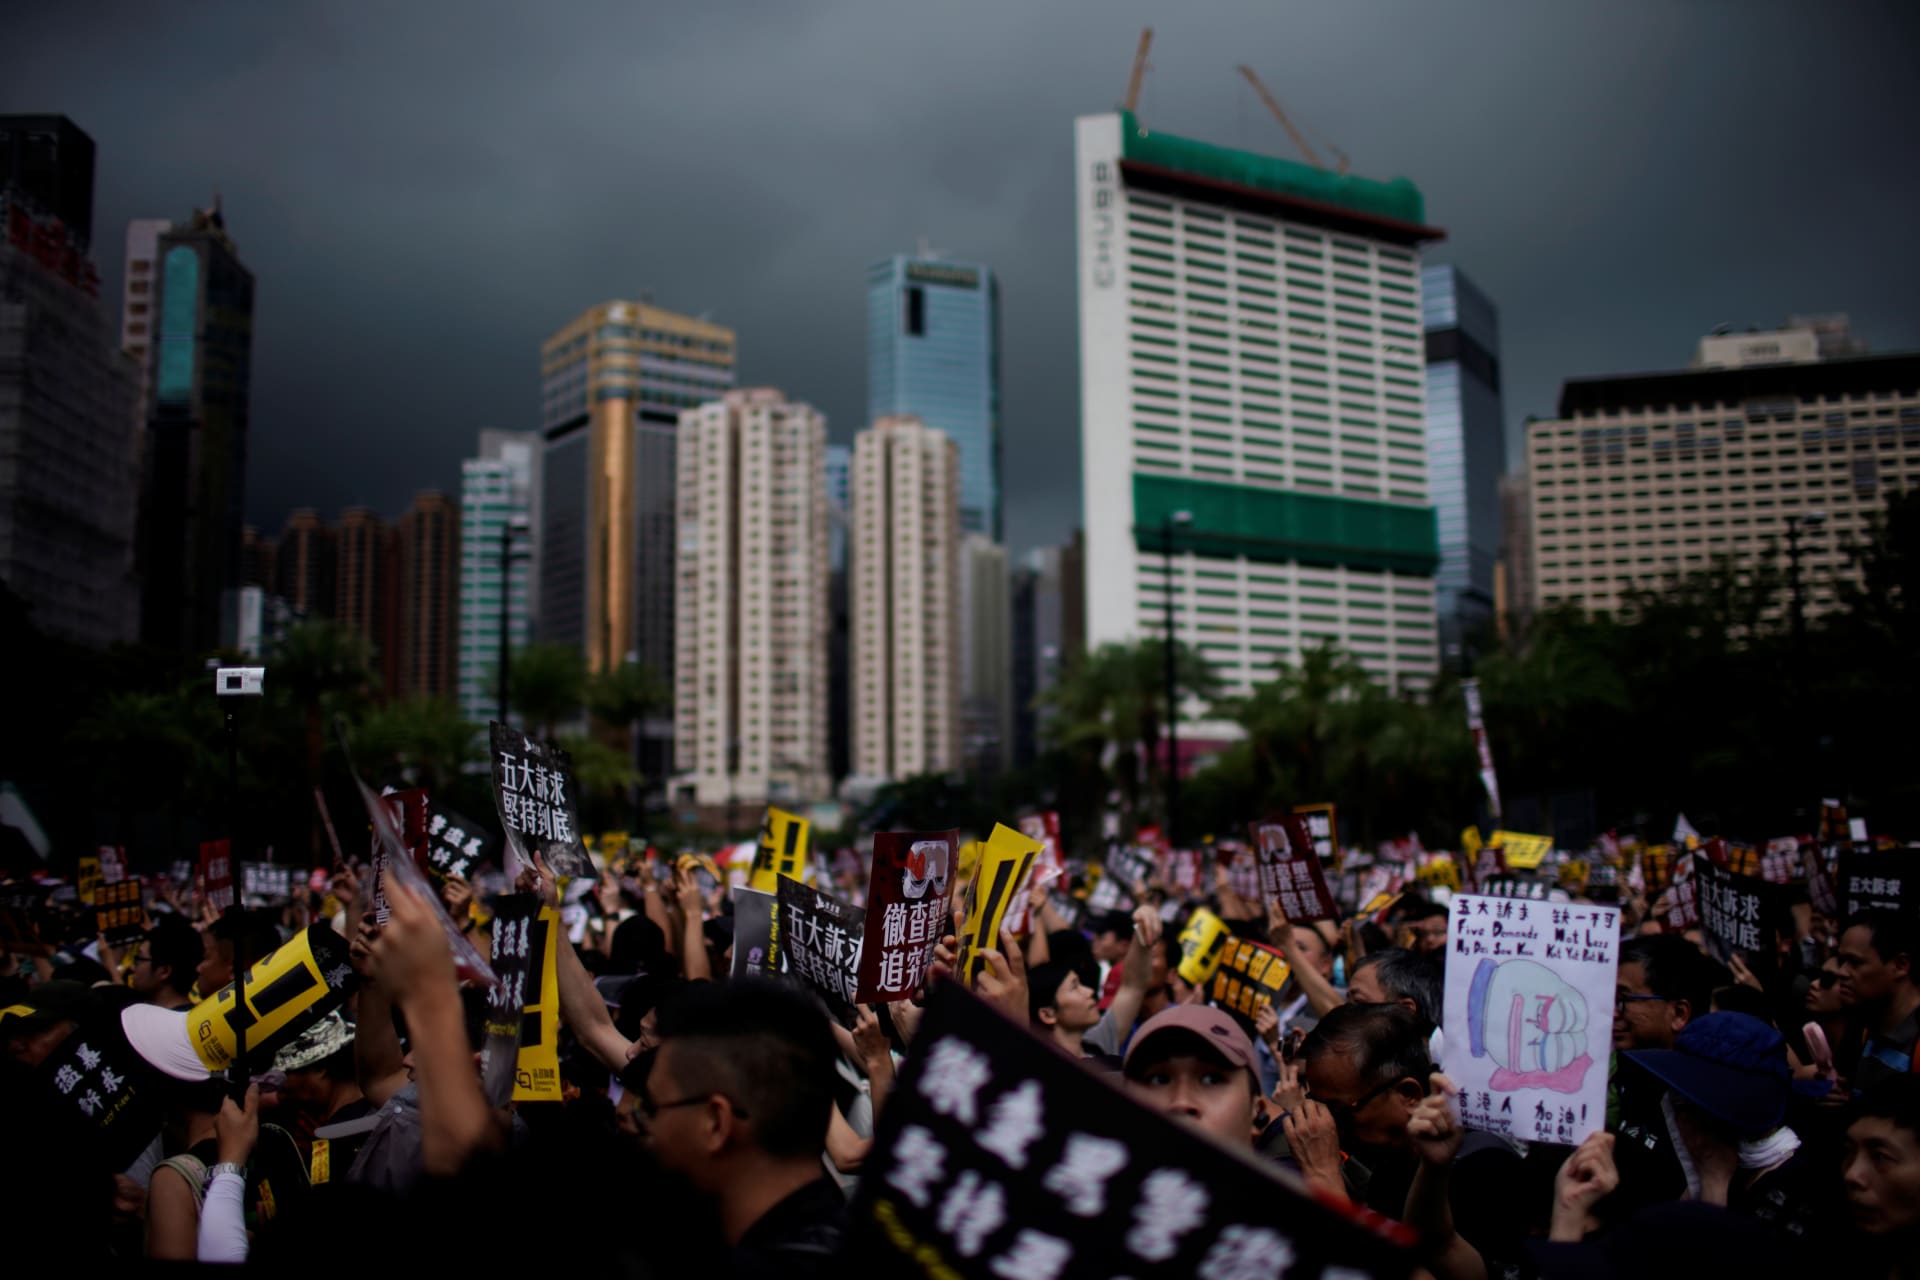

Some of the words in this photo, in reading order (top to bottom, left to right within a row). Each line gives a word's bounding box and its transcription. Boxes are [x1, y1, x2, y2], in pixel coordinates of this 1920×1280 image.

[499, 751, 567, 805] 五大訴求
[502, 790, 574, 844] 堅持到底
[1699, 872, 1761, 921] 五大訴求
[1848, 875, 1902, 896] 五大訴求
[1552, 908, 1616, 929] 缺一不可
[1457, 918, 1485, 936] Five
[1492, 921, 1538, 940] Demands
[1555, 928, 1579, 944] Not
[1585, 929, 1609, 949] Less
[1457, 1087, 1513, 1114] 香港人
[1558, 1125, 1573, 1138] Oil
